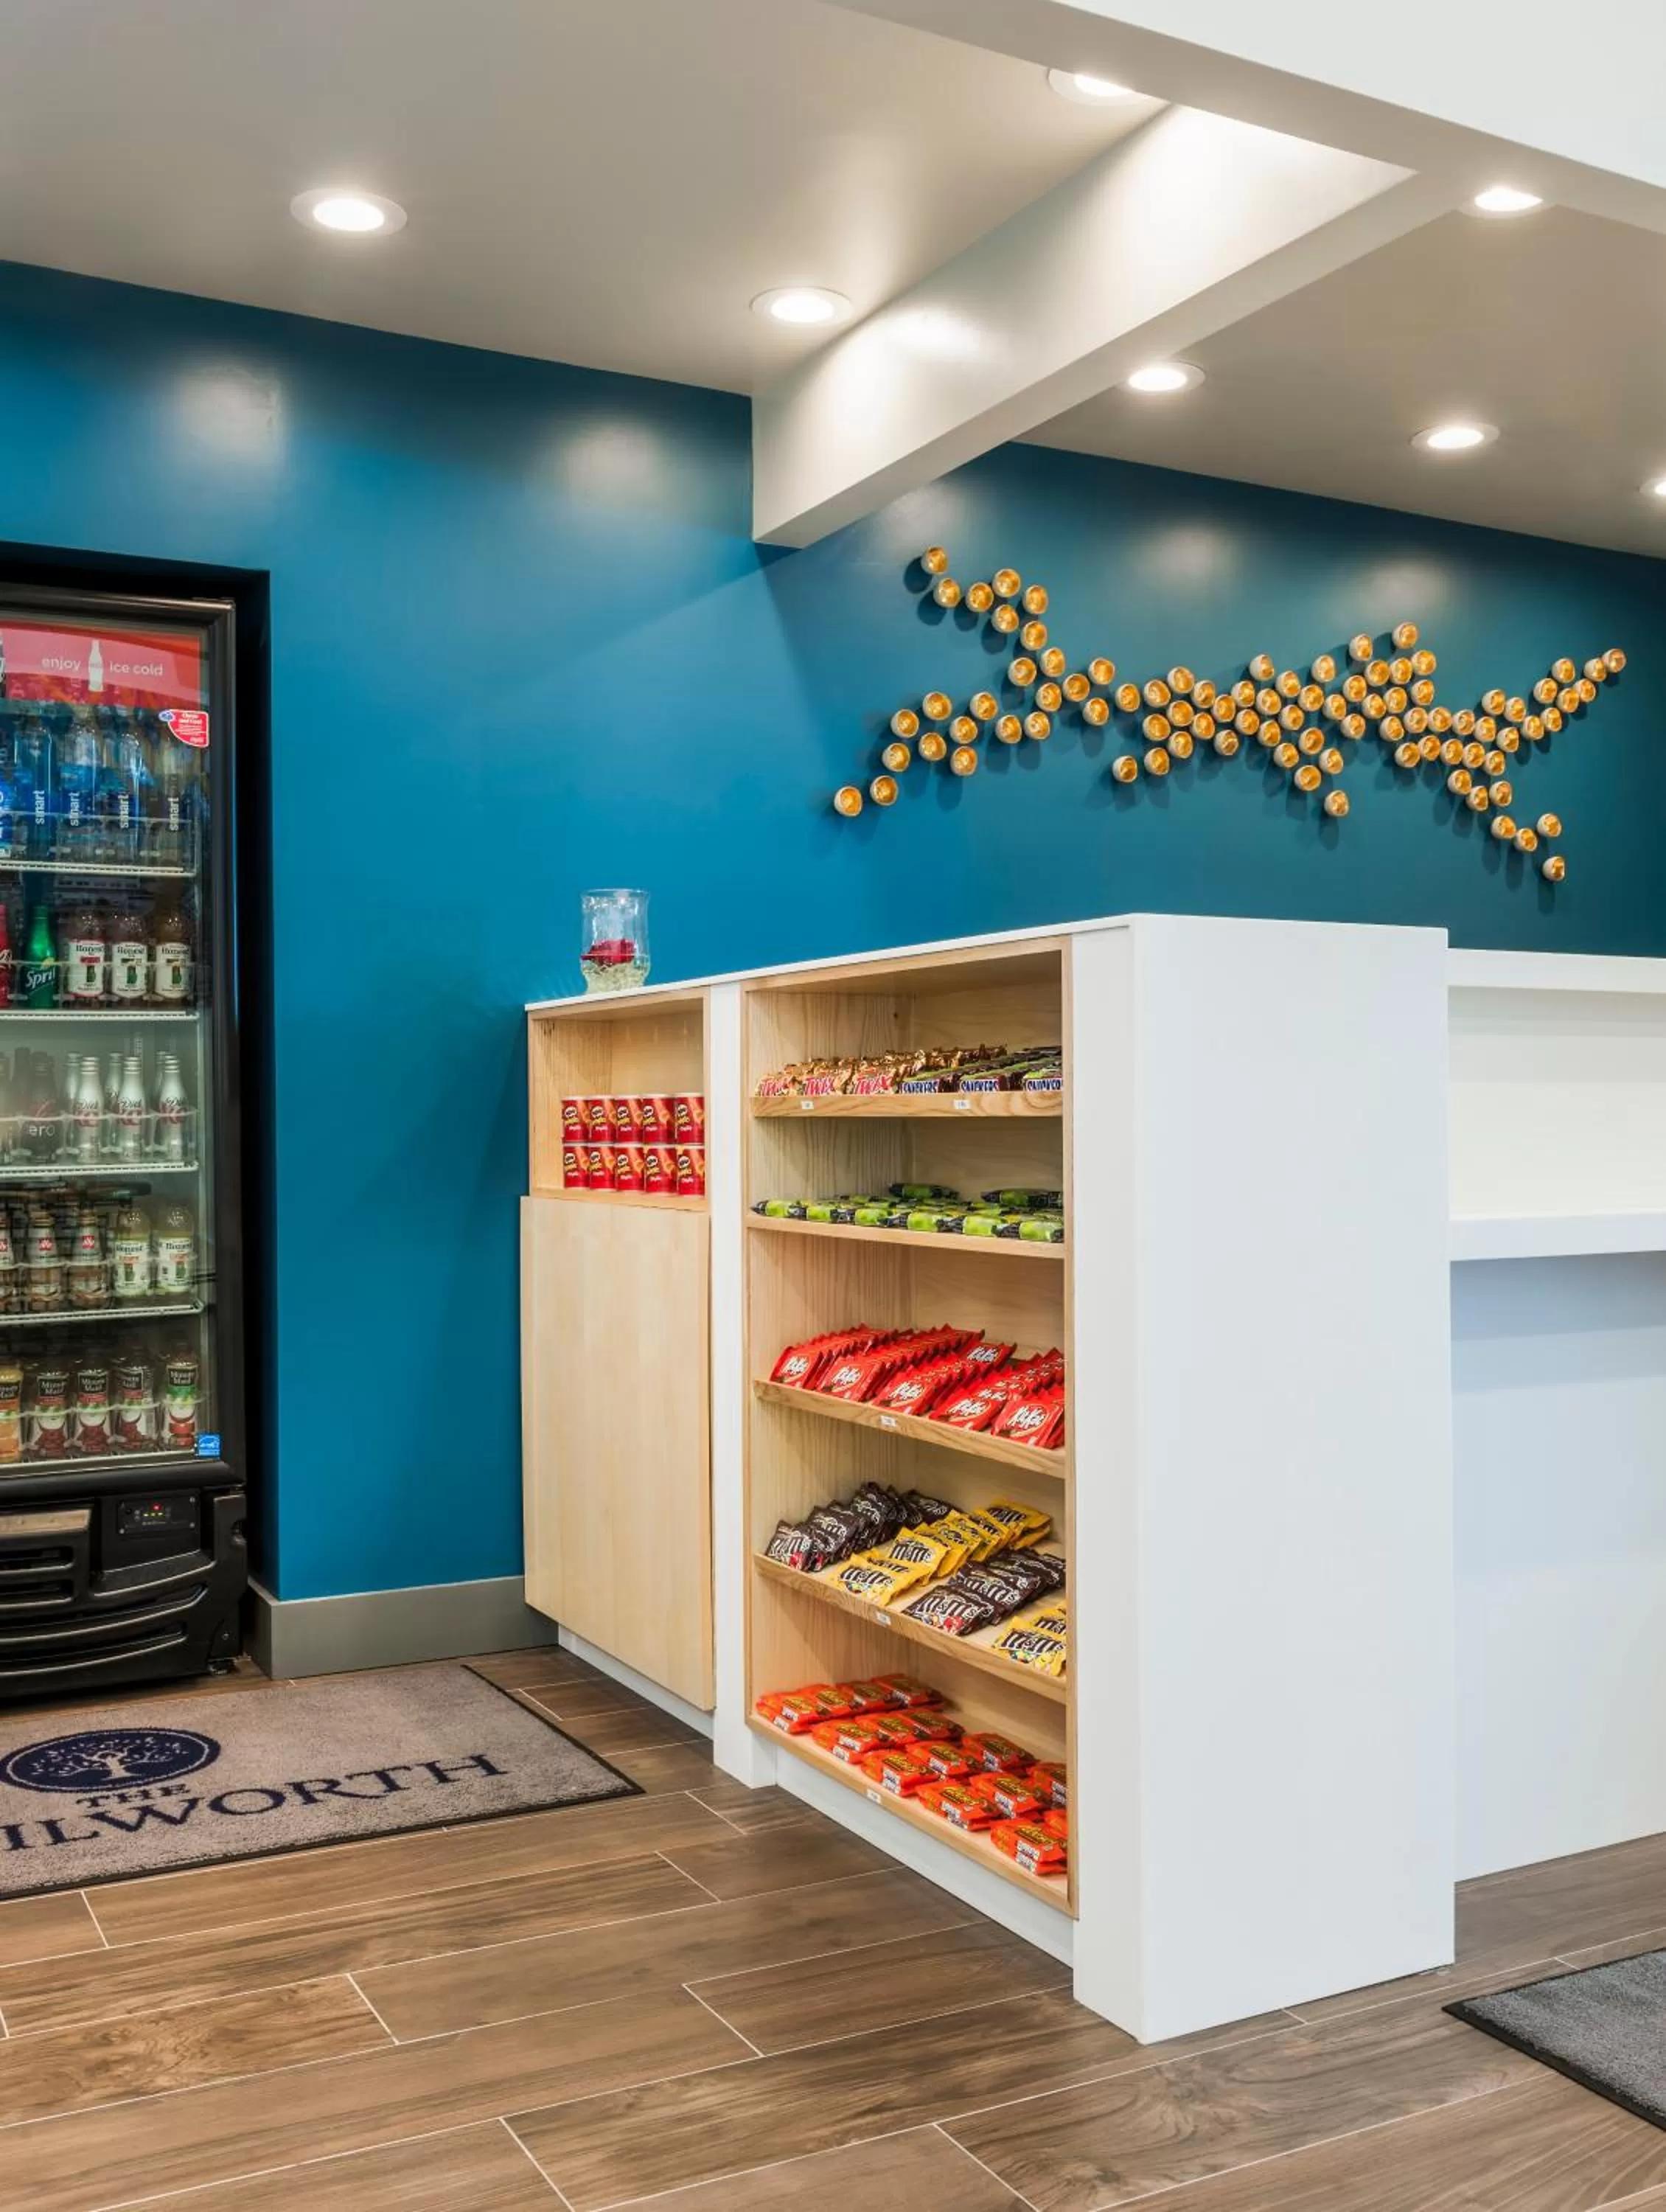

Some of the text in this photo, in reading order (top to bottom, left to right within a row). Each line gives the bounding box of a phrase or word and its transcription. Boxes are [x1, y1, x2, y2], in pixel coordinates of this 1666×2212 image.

[41, 656, 81, 671] enjoy
[133, 663, 164, 676] cold
[27, 1124, 55, 1137] ero
[0, 1754, 509, 1851] ILWORTH
[76, 1784, 190, 1808] THE
